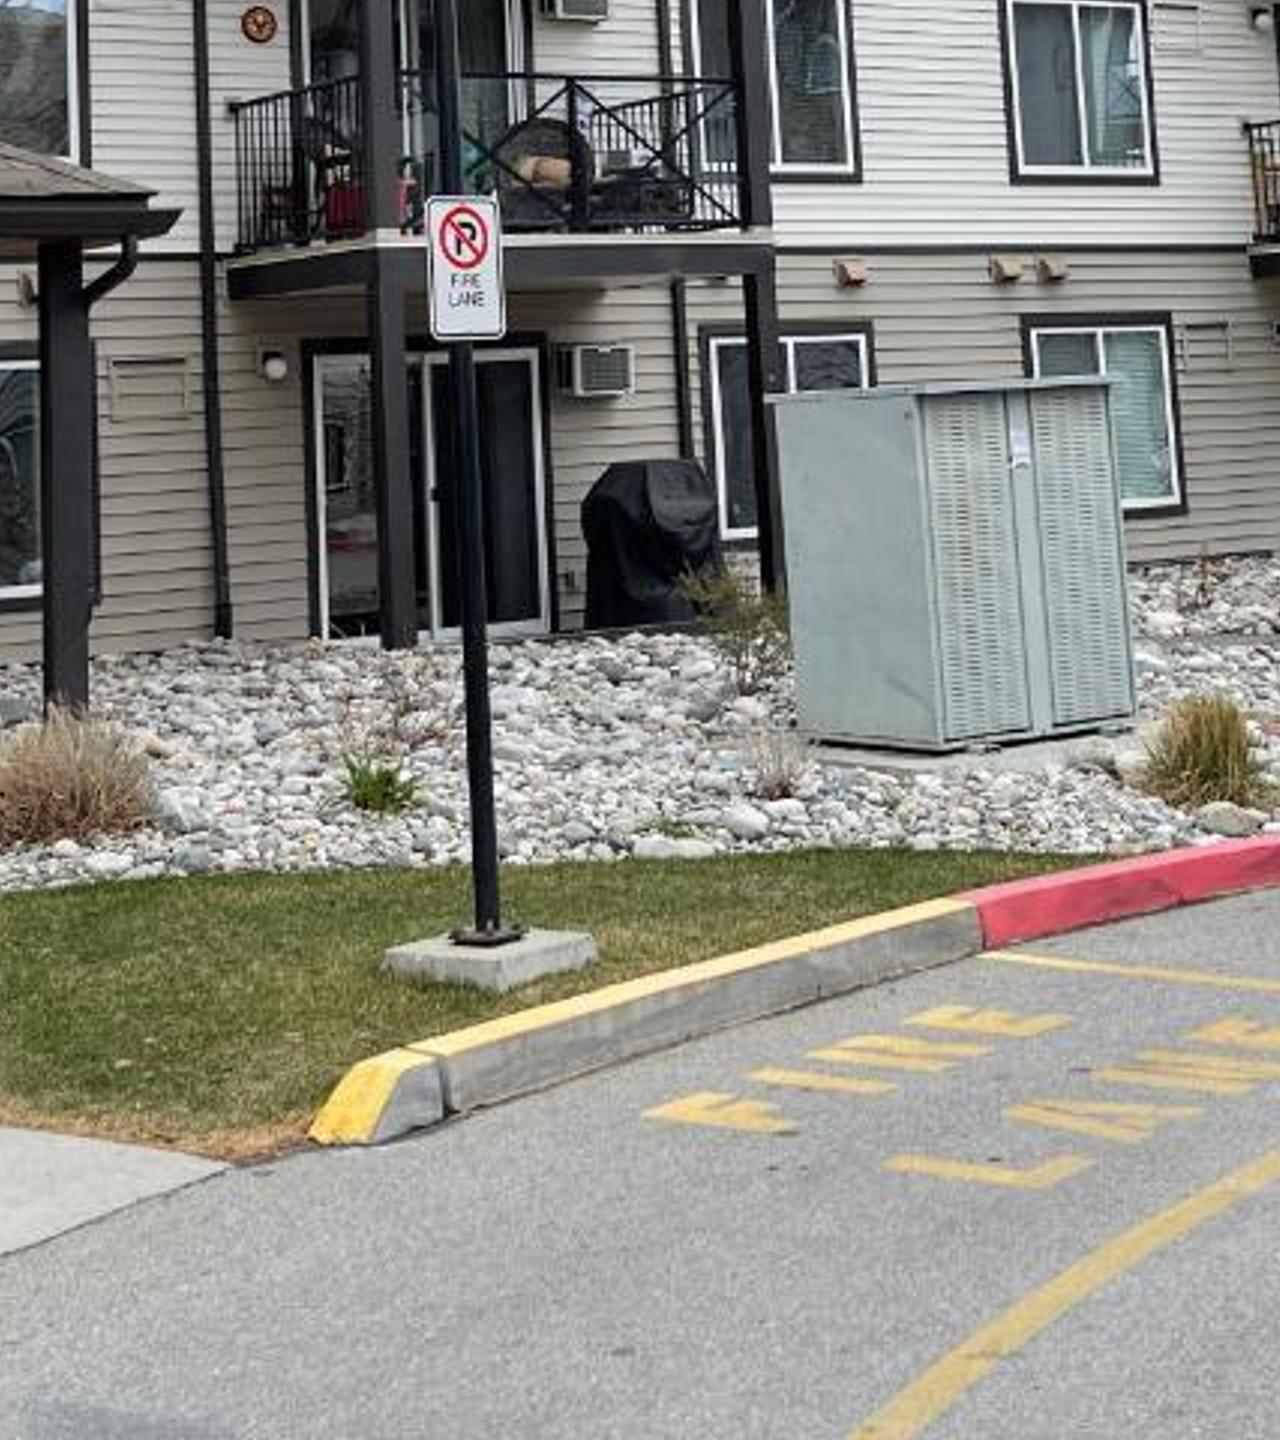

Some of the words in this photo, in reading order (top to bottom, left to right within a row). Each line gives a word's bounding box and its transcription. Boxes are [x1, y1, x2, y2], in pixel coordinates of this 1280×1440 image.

[450, 272, 481, 289] FIRE
[448, 291, 484, 308] LANE
[640, 1004, 1077, 1136] FIRE
